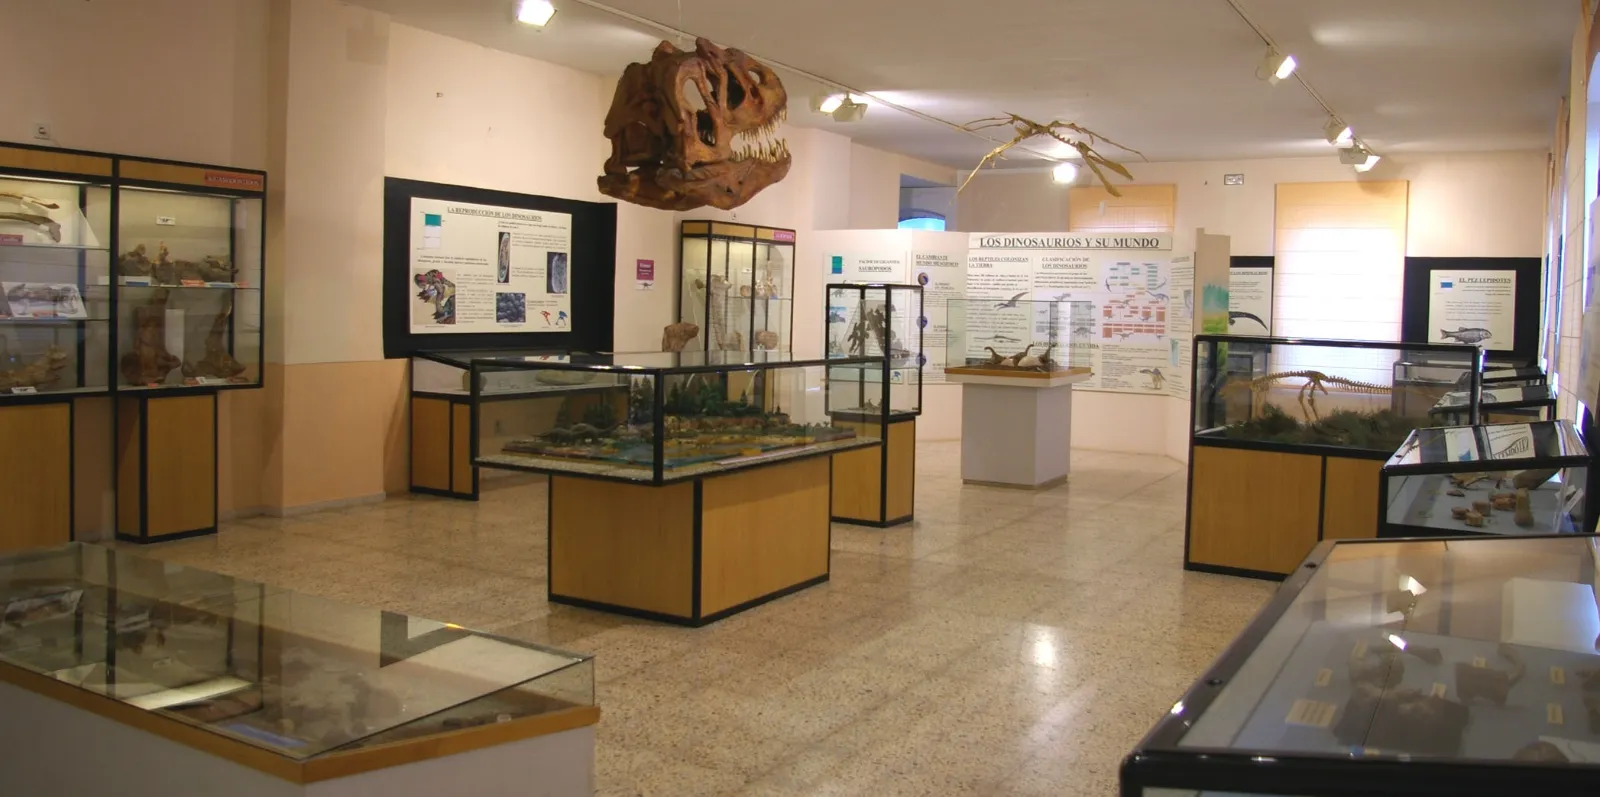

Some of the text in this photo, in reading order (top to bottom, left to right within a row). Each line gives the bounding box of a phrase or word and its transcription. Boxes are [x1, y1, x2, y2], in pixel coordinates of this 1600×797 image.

[980, 237, 1160, 248] LOS DINOSAURIOS Y SU MUNDO
